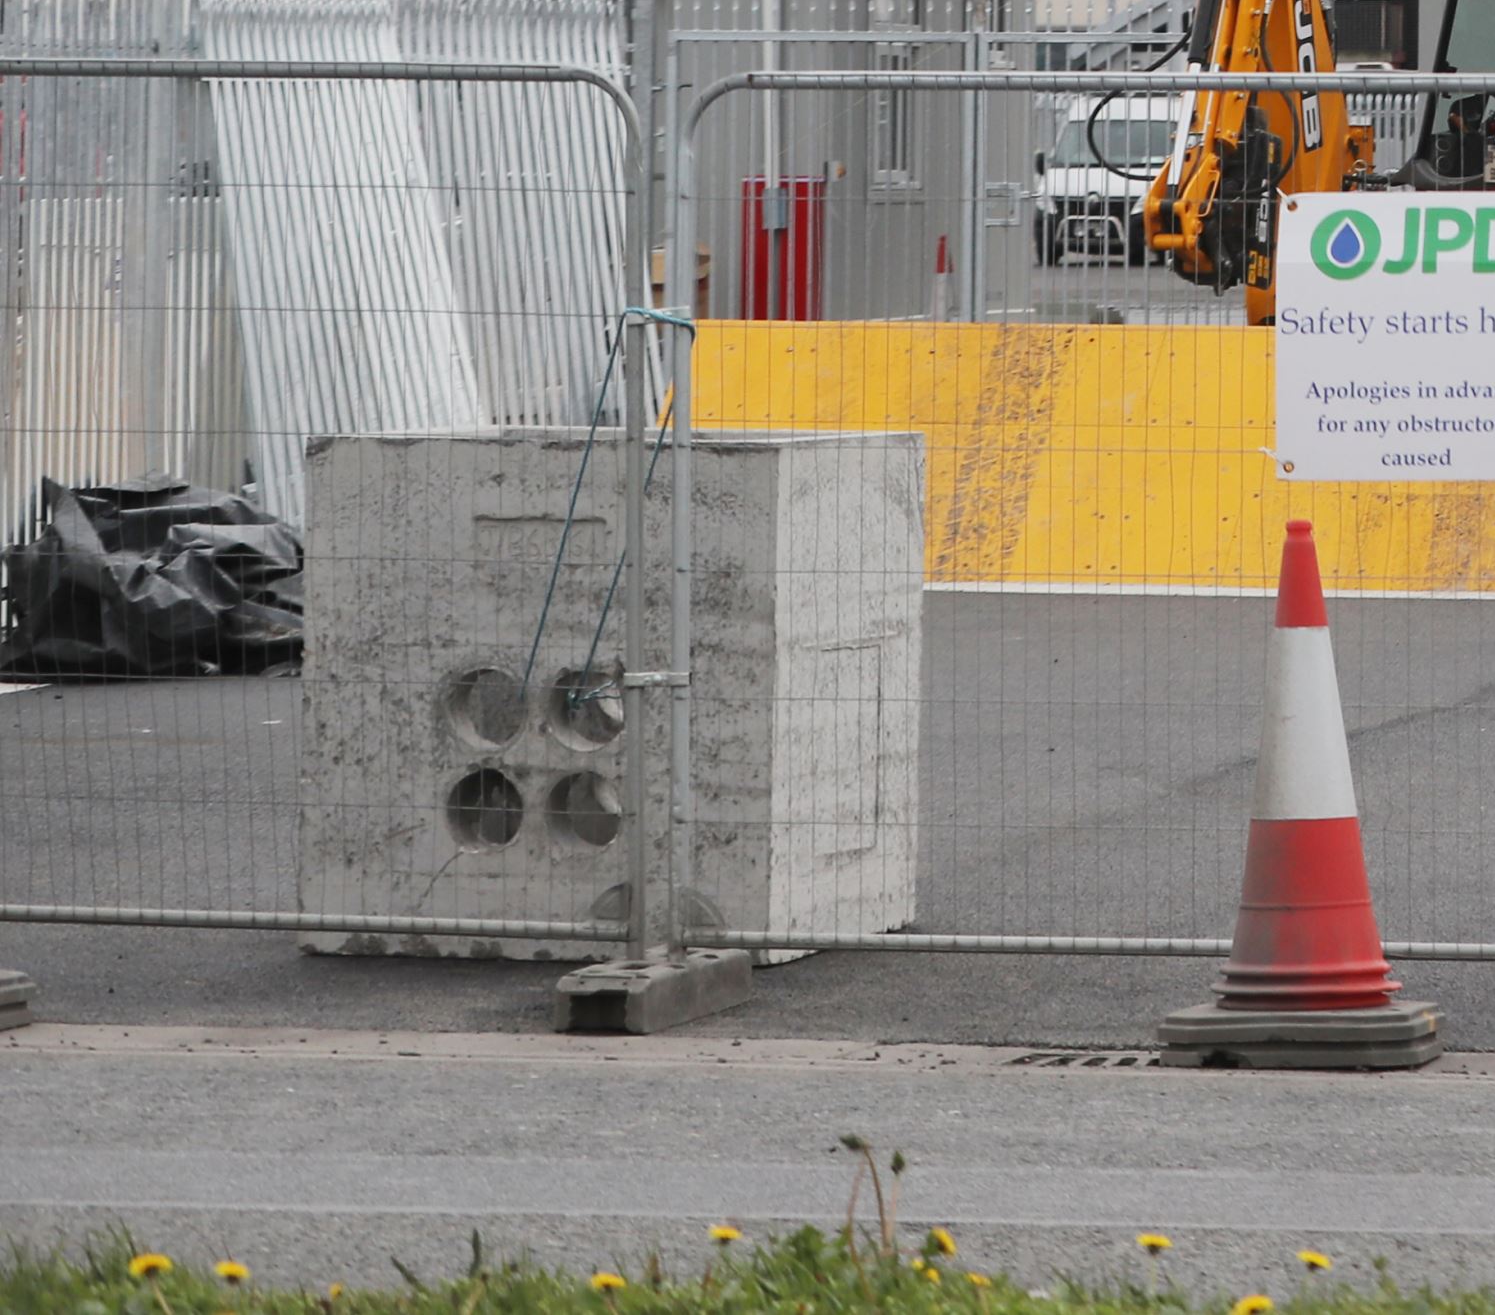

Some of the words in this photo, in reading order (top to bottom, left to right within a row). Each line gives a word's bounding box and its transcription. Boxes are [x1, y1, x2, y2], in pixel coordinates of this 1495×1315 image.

[1281, 307, 1375, 344] Safety
[1385, 311, 1468, 335] starts
[1305, 381, 1411, 405] Apologies
[1418, 381, 1437, 399] in
[1317, 415, 1348, 433] for
[1353, 419, 1391, 438] any
[1381, 449, 1452, 467] caused
